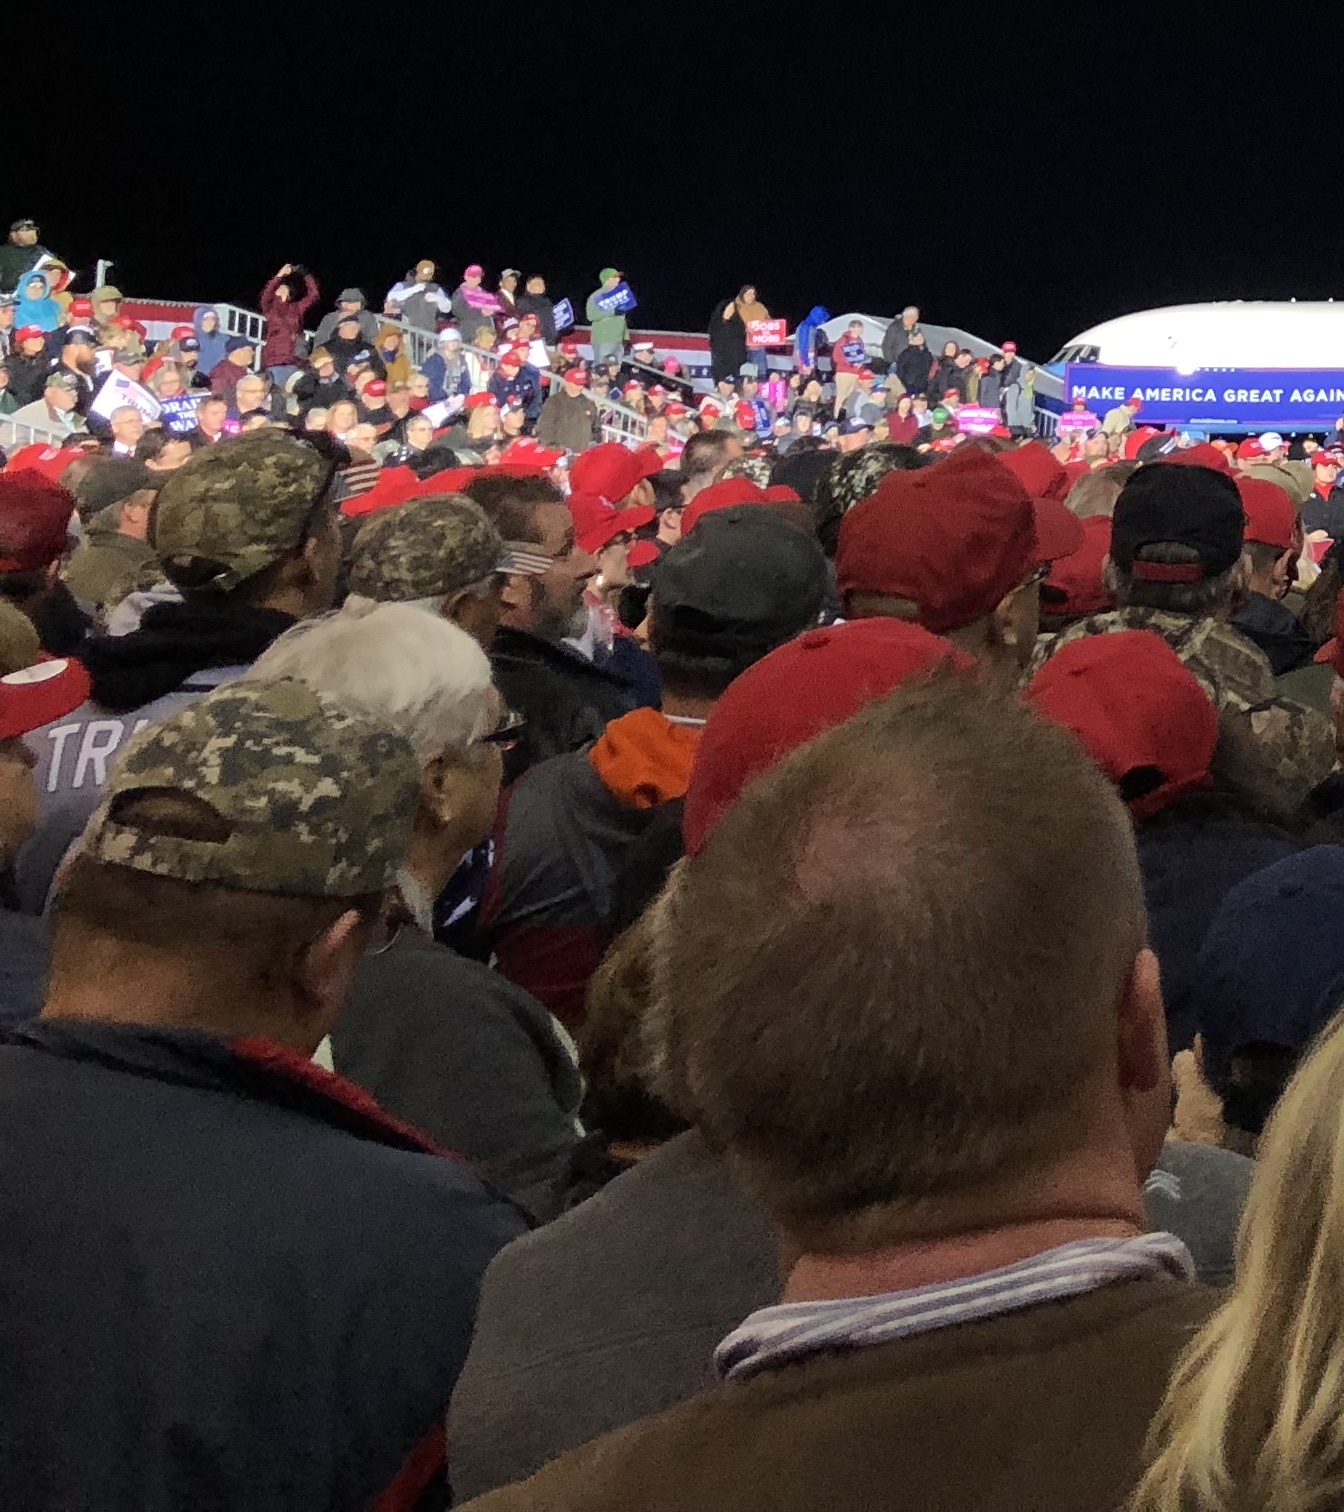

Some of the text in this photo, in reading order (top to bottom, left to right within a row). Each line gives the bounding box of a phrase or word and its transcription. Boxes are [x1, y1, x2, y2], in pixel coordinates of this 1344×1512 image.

[1072, 385, 1125, 400] MAKE
[1132, 388, 1216, 402] AMERICA
[1223, 389, 1284, 402] GREAT
[47, 720, 149, 791] TR
